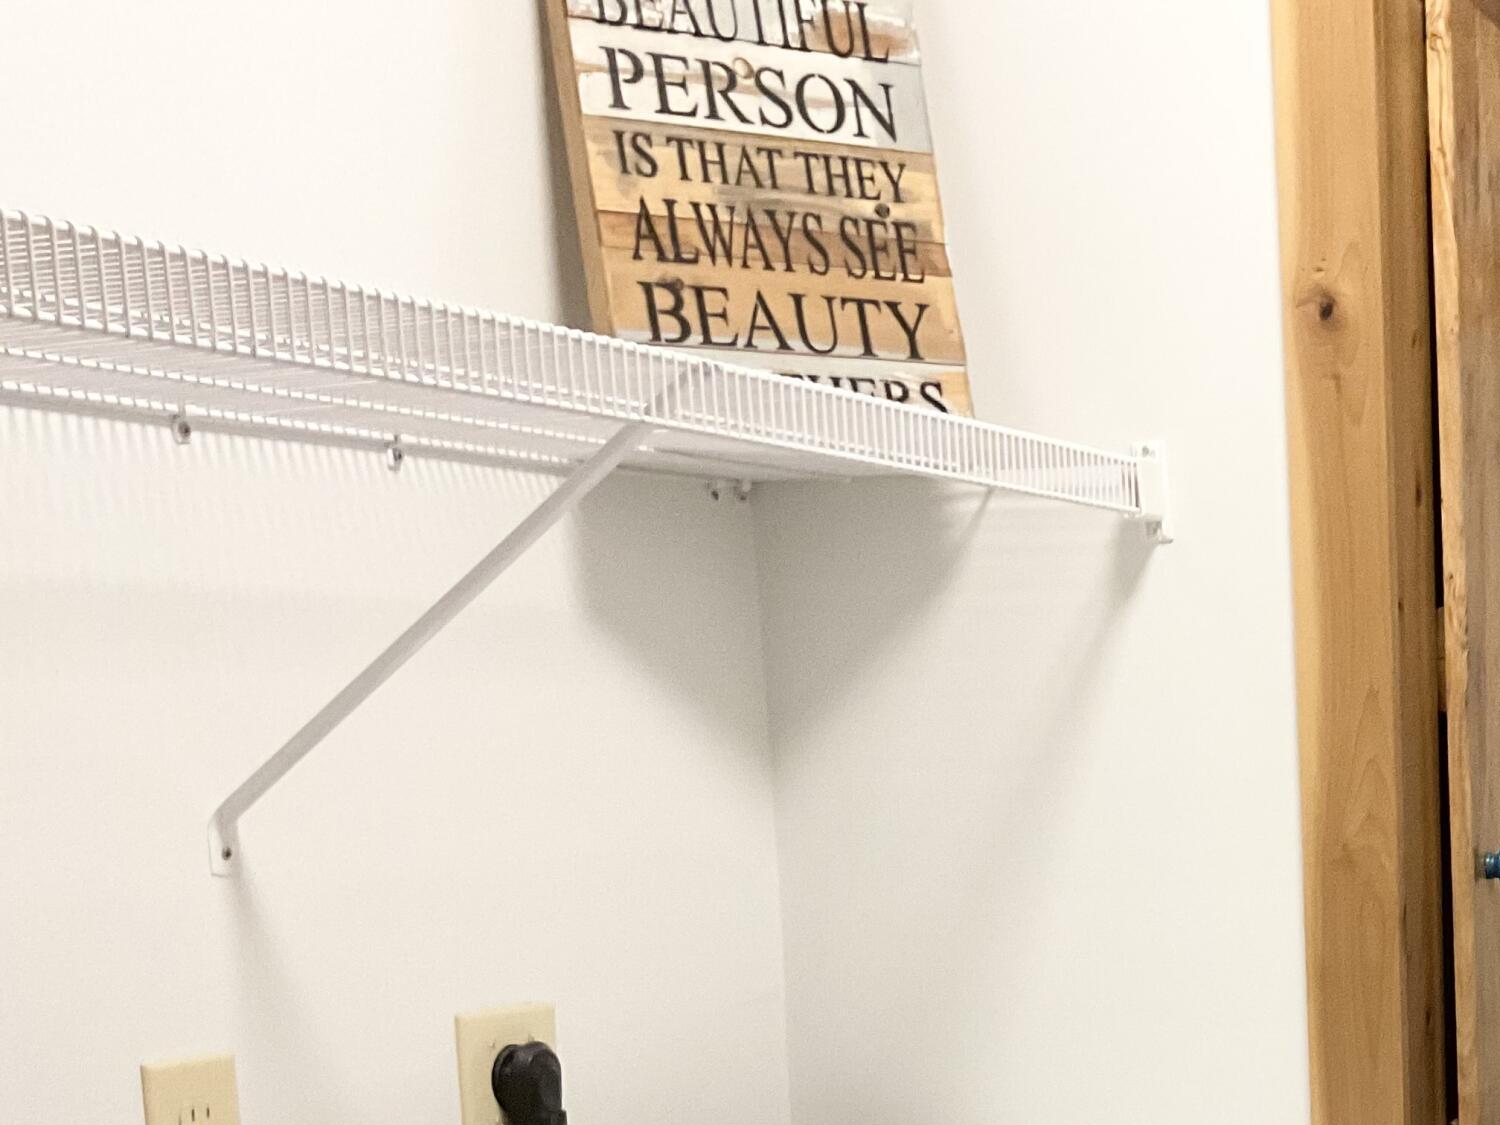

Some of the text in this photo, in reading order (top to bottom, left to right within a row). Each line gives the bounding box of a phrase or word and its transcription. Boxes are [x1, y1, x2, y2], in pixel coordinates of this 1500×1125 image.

[599, 46, 897, 142] PERSON
[612, 130, 906, 203] IS THAT THEY
[632, 195, 925, 284] ALWAYS SEE
[637, 280, 930, 360] BEAUTY
